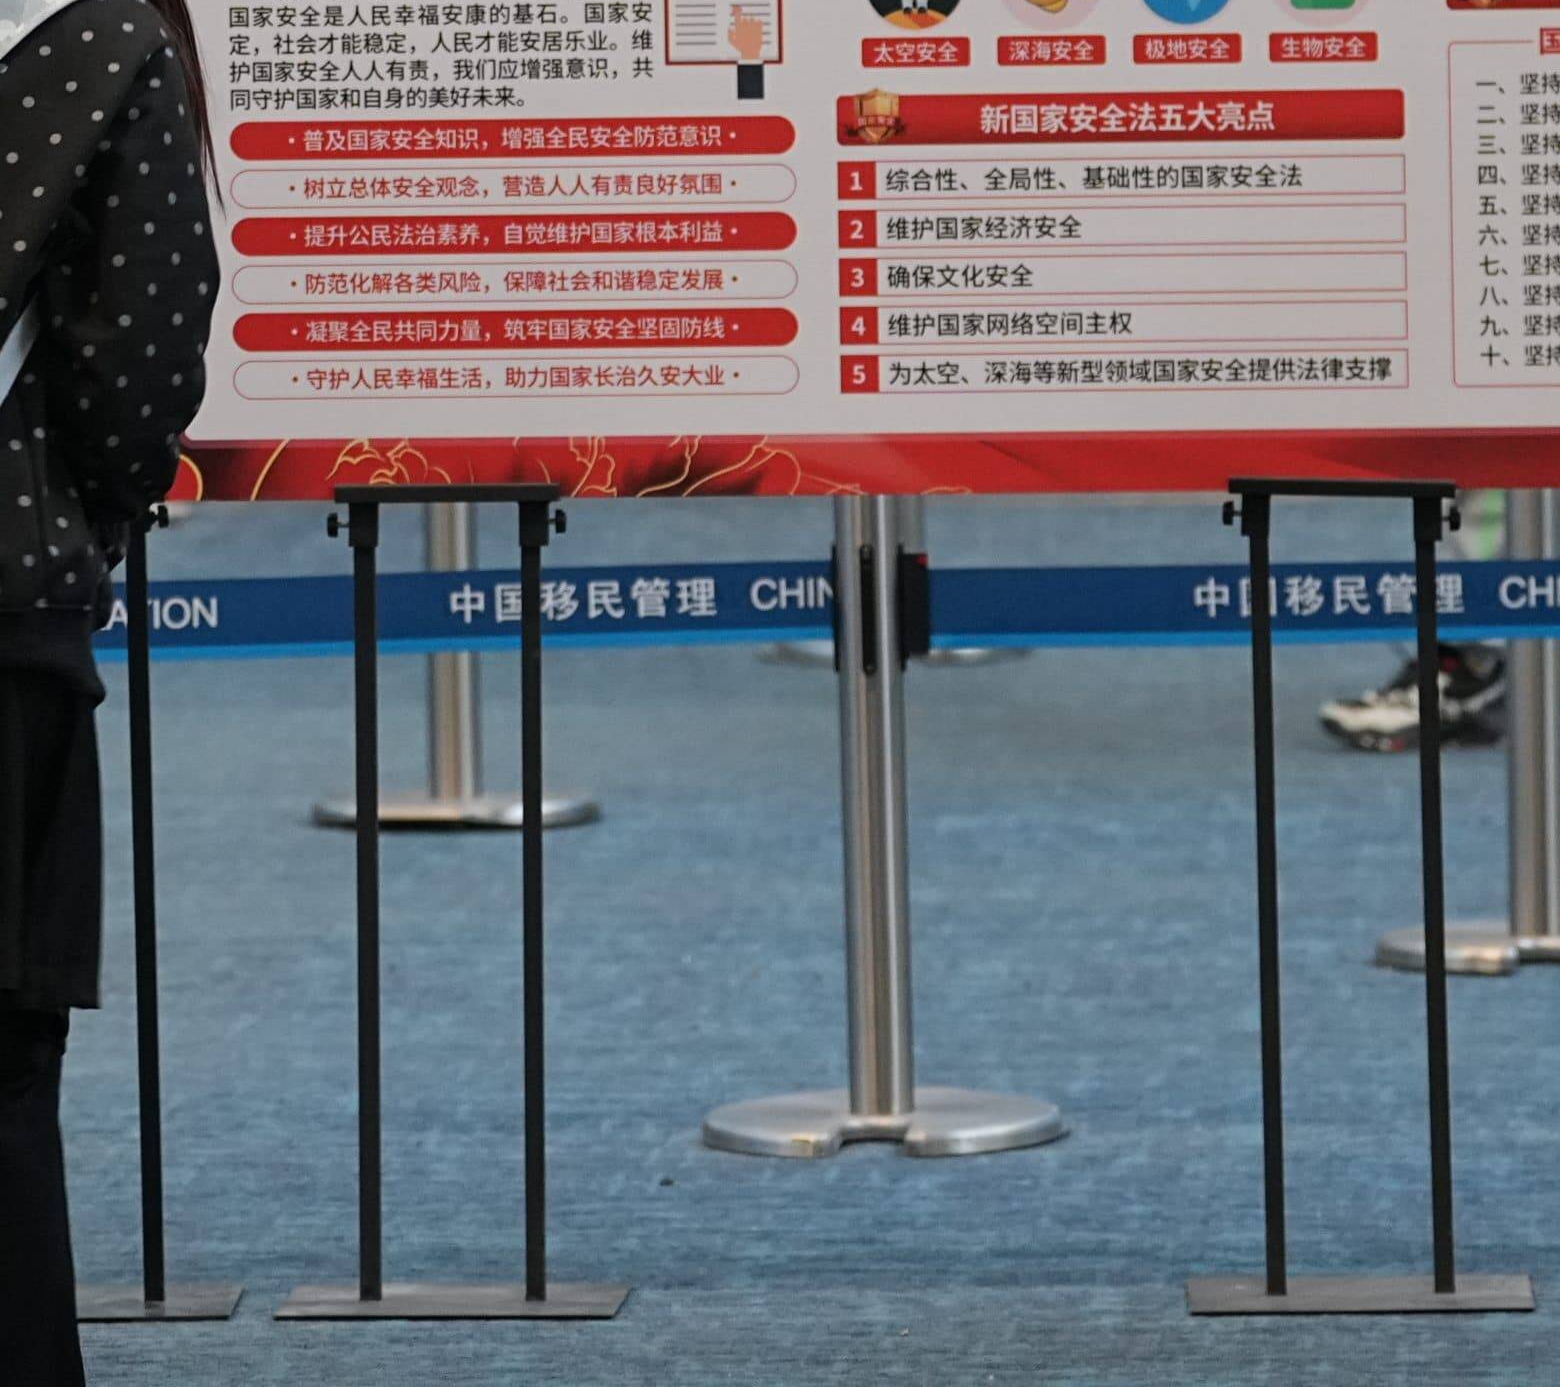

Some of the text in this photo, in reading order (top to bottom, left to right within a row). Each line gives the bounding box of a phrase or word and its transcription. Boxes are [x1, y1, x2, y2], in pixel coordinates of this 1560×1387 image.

[229, 2, 652, 28] 国家安全是人民幸福安康的基石。国家安
[229, 29, 654, 56] 定，社会才能稳定，人民才能安居乐业。维
[874, 42, 958, 63] 太空安全
[1009, 40, 1094, 61] 深海安全
[1145, 38, 1229, 59] 极地安全
[1282, 36, 1366, 58] 生物安全
[229, 56, 654, 84] 护国家安全人人有责，我们应增强意识，共
[230, 84, 527, 112] 同守护国家和自身的美好未来。
[980, 101, 1275, 135] 新国家安全法五大亮点
[303, 124, 722, 152] 普及国家安全知识，增强全民安全防范意识
[303, 173, 722, 200] 树立总体安全观念，营造人人有责良好氛围
[849, 164, 1302, 192] 1 综合性、全局性、基础性的国家安全法
[304, 220, 723, 248] 提升公民法治素养，自觉维护国家根本利益
[849, 215, 1082, 241] 2 维护国家经济安全
[304, 268, 724, 296] 防范化解各类风险，保障社会和谐稳定发展
[850, 264, 1034, 289] 3 确保文化安全
[305, 315, 725, 344] 凝聚全民共同力量，筑牢国家安全坚固防线
[851, 311, 1132, 338] 4 维护国家网络空间主权
[306, 364, 725, 392] 守护人民幸福生活，助力国家长治久安大业
[852, 356, 1392, 386] 5 为太空、深海等新型领域国家安全提供法律支撑
[105, 596, 218, 630] AION
[450, 577, 718, 624] 中国移民管理
